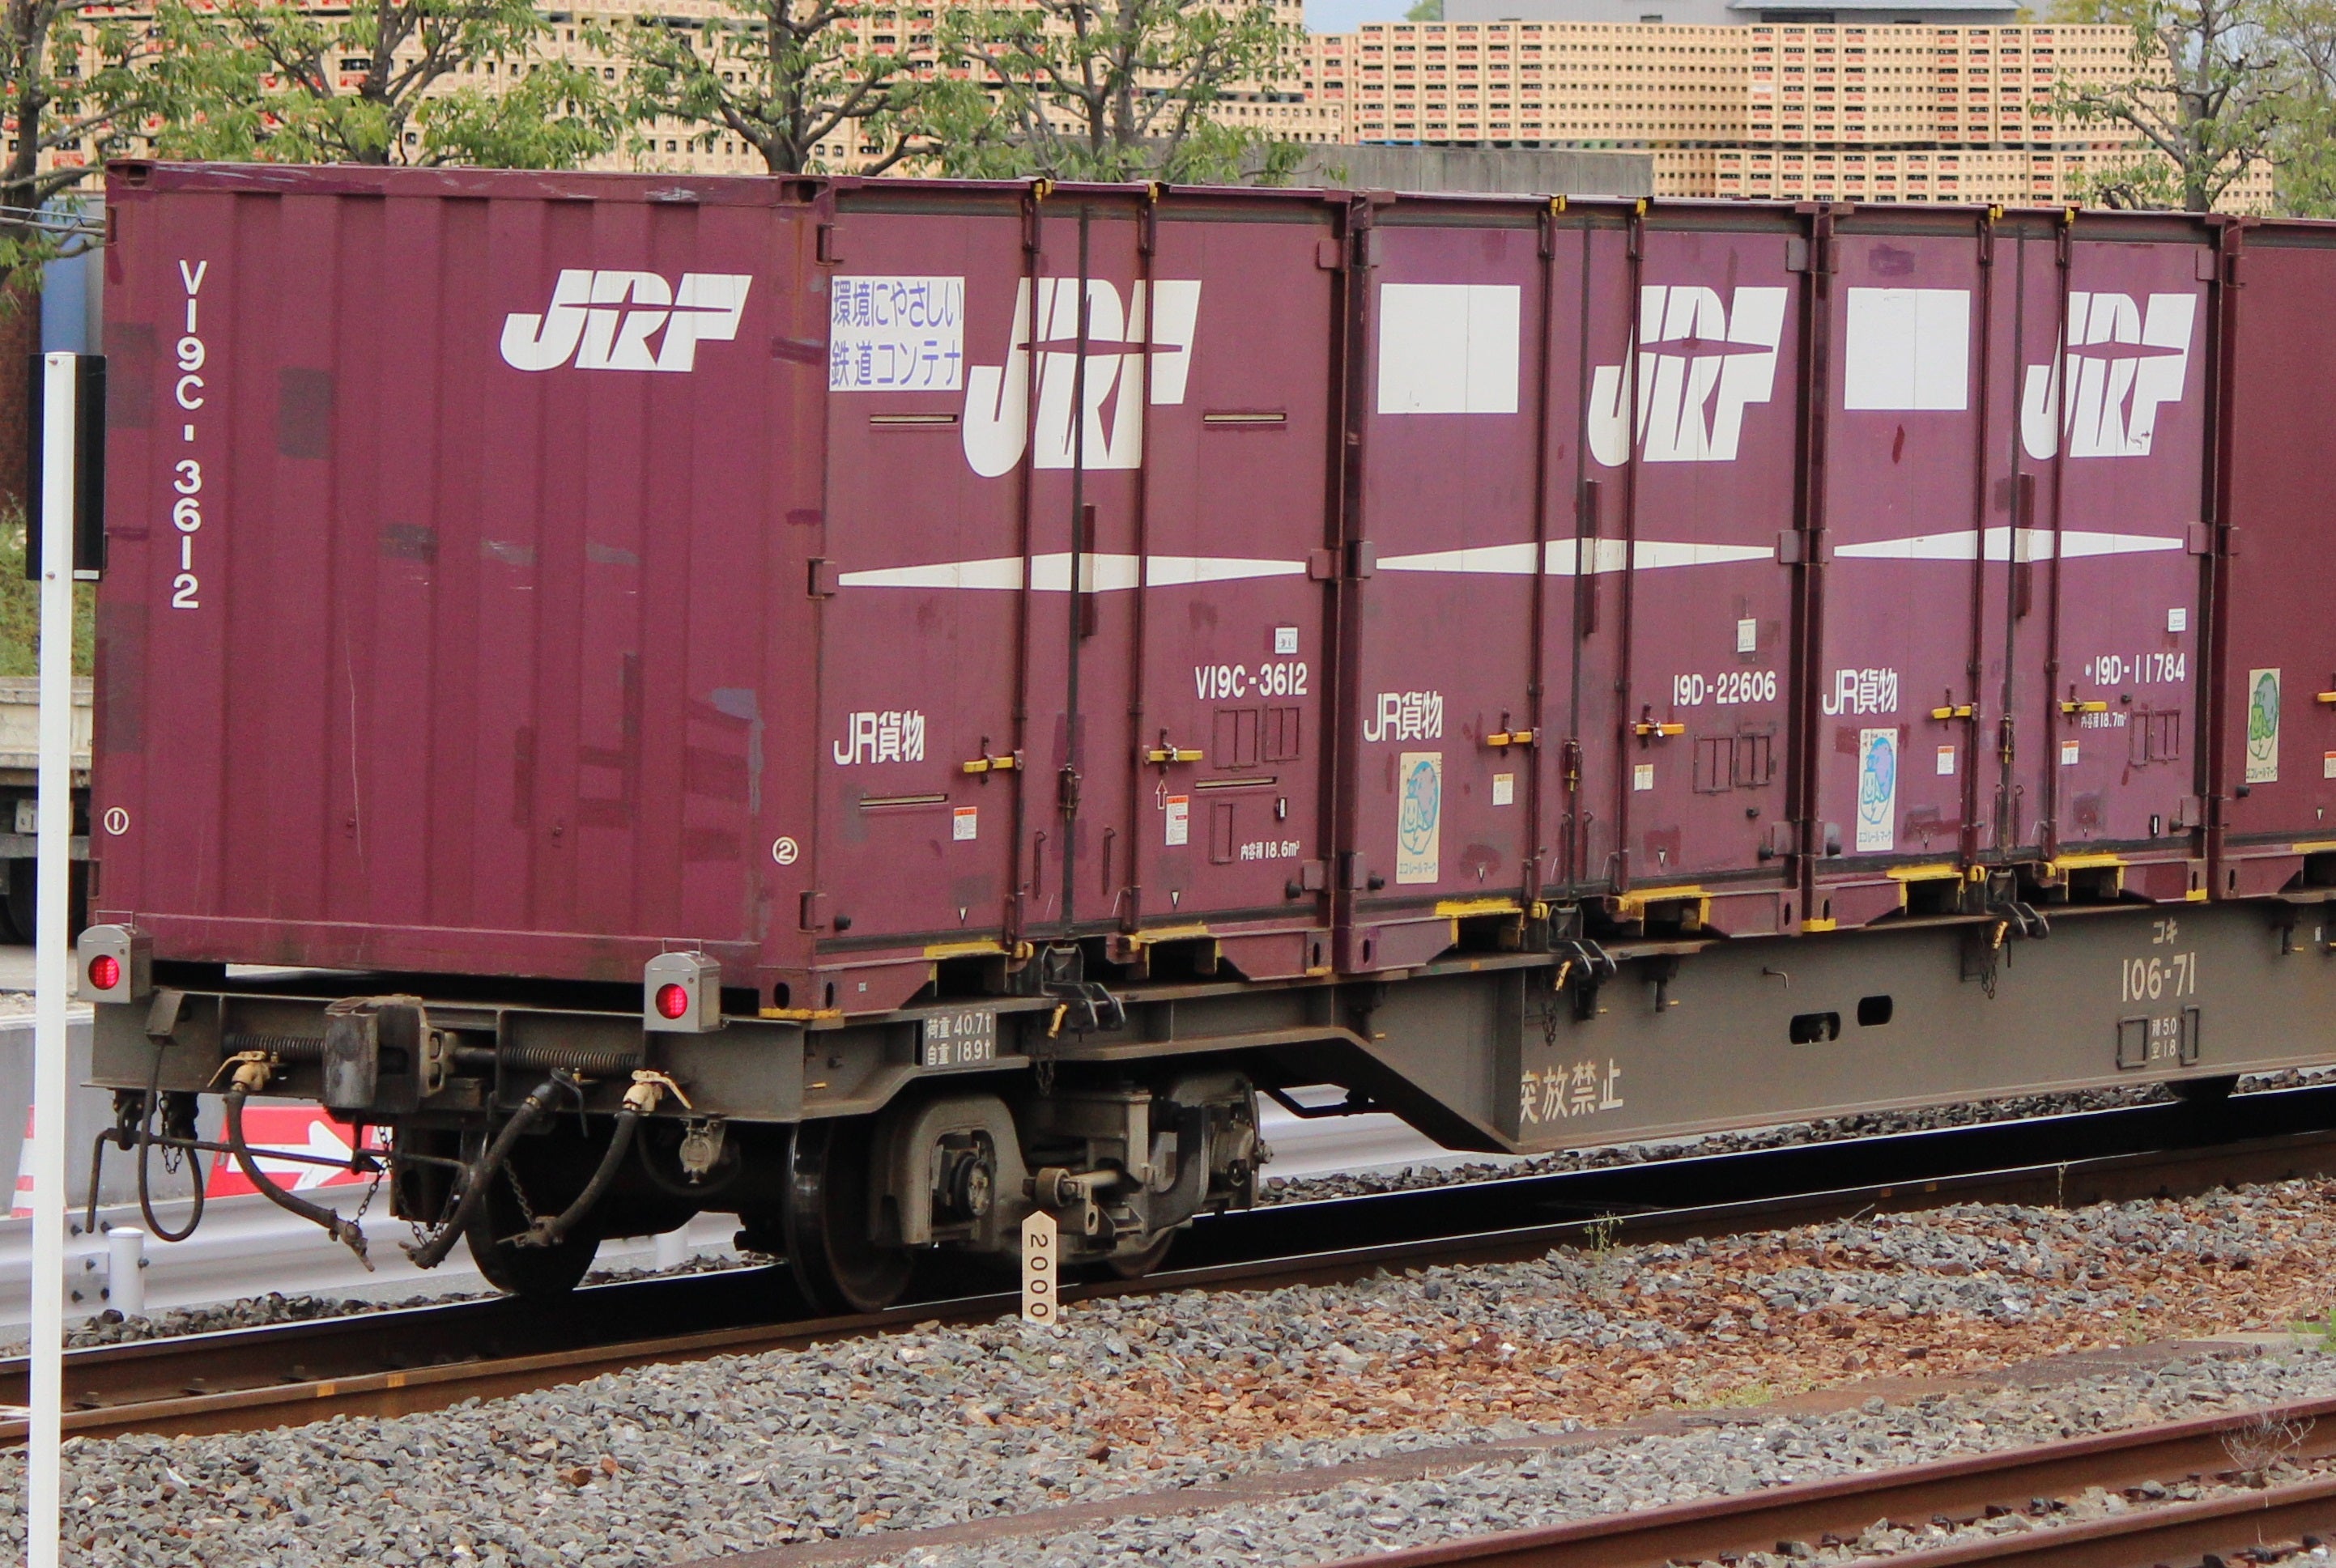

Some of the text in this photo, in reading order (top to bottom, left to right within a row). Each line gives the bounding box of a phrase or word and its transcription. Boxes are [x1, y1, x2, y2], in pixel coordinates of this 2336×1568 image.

[500, 270, 753, 372] JRF
[832, 280, 962, 327] 環境にやさしい
[832, 339, 961, 386] 鉄道コンテナ
[962, 277, 1202, 477] JRF
[1588, 285, 1788, 466] JRF
[2021, 291, 2197, 460] JRF
[172, 260, 207, 609] V19C-3612
[1194, 661, 1308, 700] V19C-3612
[1673, 670, 1776, 707] 19D-22606
[1822, 667, 1898, 715] JR貨物
[2095, 652, 2185, 686] 19D-11784
[833, 710, 925, 766] JR貨物
[1364, 691, 1443, 742] JR貨物
[2152, 917, 2178, 945] コキ
[2122, 951, 2195, 1002] 106-71
[1520, 1058, 1623, 1124] 突放禁止
[1030, 1233, 1049, 1317] 2000
